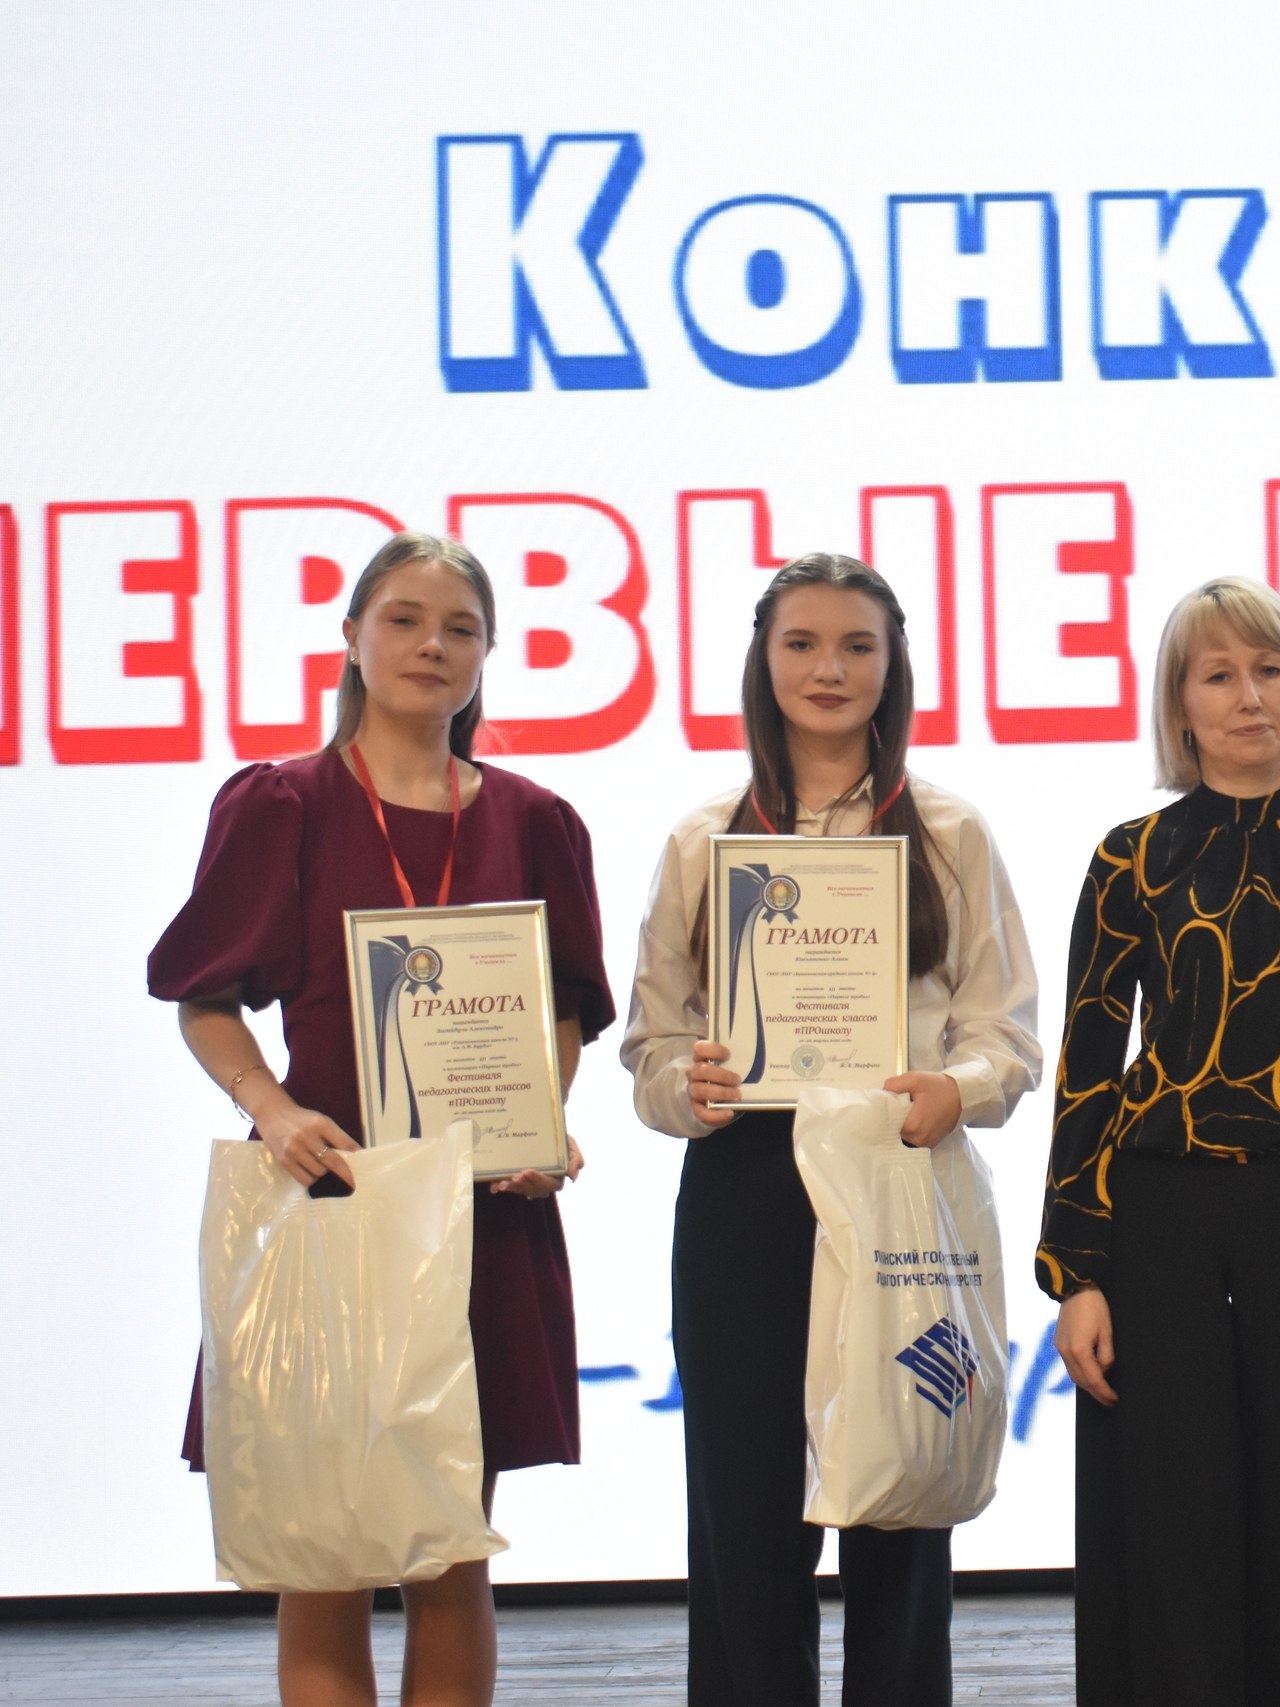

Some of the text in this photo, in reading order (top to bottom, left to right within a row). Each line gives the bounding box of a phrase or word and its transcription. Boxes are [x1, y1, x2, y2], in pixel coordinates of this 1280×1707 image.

[0, 481, 1138, 768] ЕРВЫЕ
[765, 927, 879, 945] ГРАМОТА
[411, 994, 526, 1018] ГРАМОТА
[795, 1001, 850, 1011] Фестиваля
[765, 1013, 878, 1023] педагогических классов
[794, 1026, 852, 1037] #ПРОшколу
[447, 1072, 502, 1083] Фестиваля
[417, 1082, 532, 1098] педагогических классов
[448, 1097, 507, 1108] #ПРОшколу
